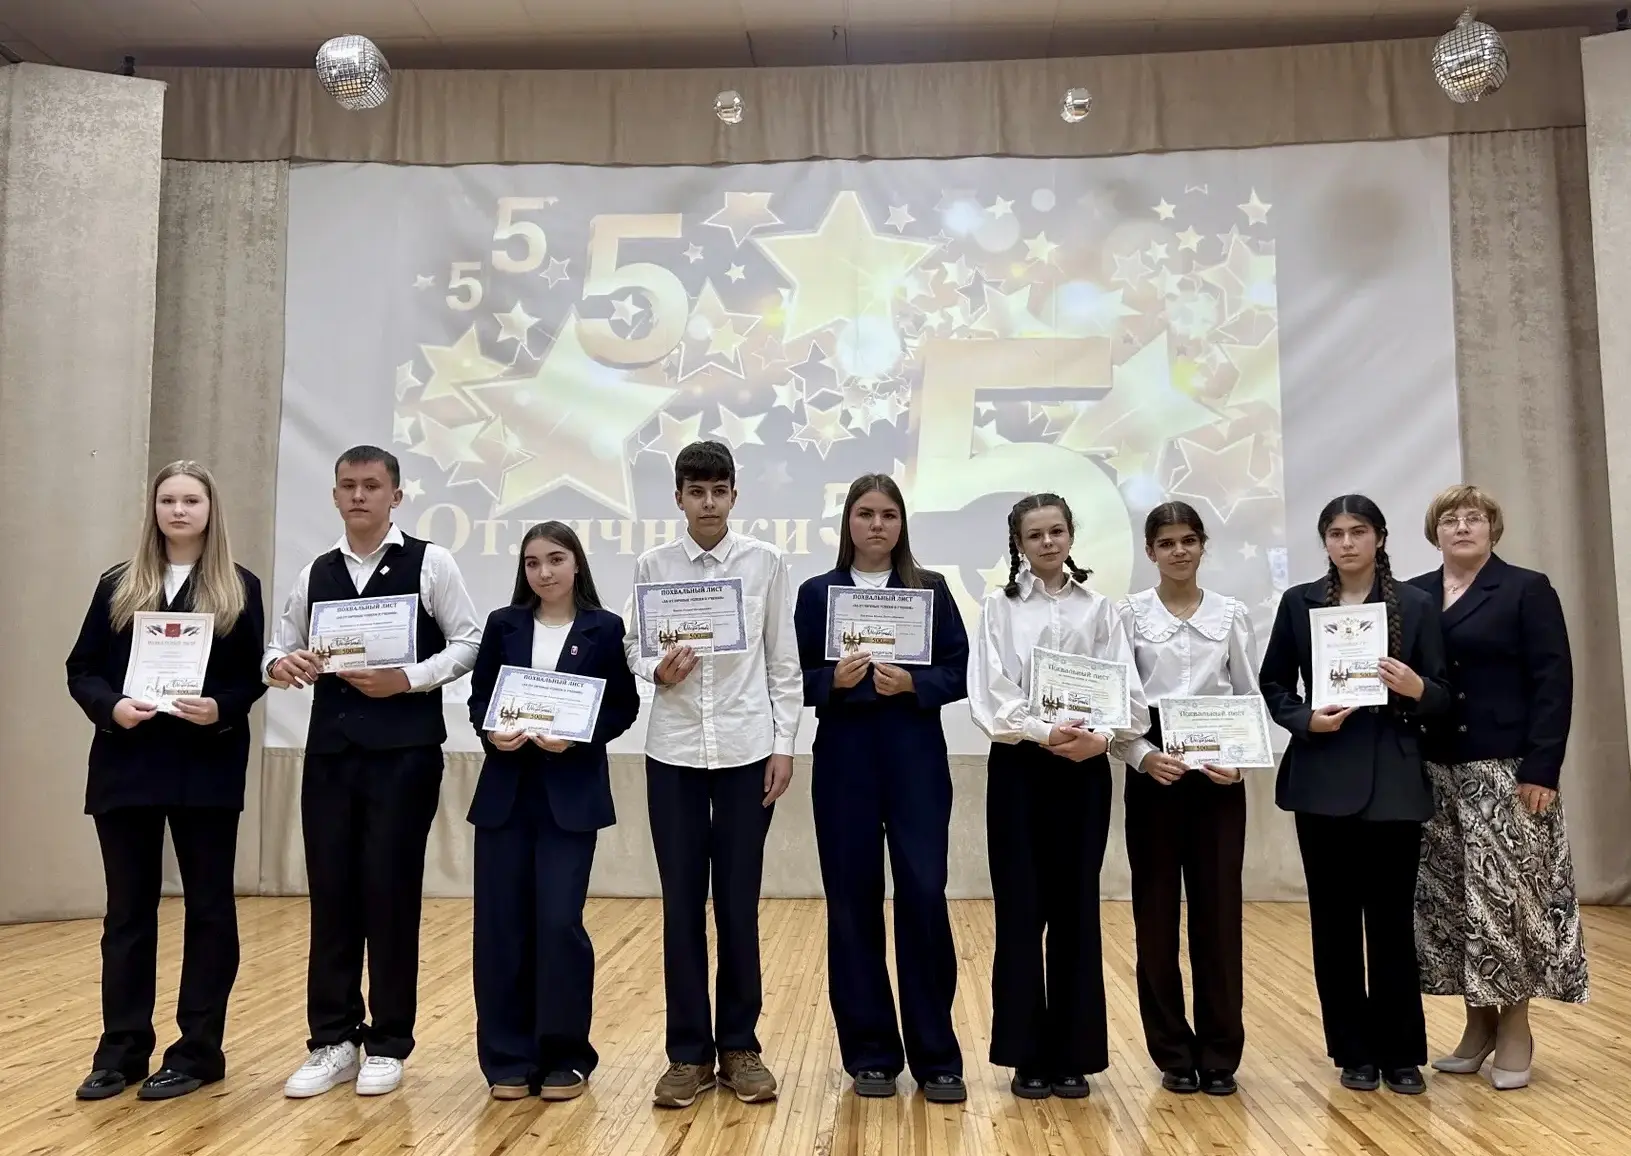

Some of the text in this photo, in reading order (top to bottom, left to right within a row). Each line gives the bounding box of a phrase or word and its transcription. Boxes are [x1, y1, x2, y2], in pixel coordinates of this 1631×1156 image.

[491, 196, 547, 273] 5
[446, 261, 483, 311] 5
[575, 212, 689, 370] 5
[415, 502, 812, 555] Отчнки
[660, 587, 706, 596] ПОХВАЛЬНЫЙ
[852, 594, 896, 602] ПОХВАЛЬНЫЙ
[336, 603, 381, 613] ПОХВАЛЬНЫЙ
[523, 674, 585, 688] ПОХВАЛЬНЫЙ ЛИСТ
